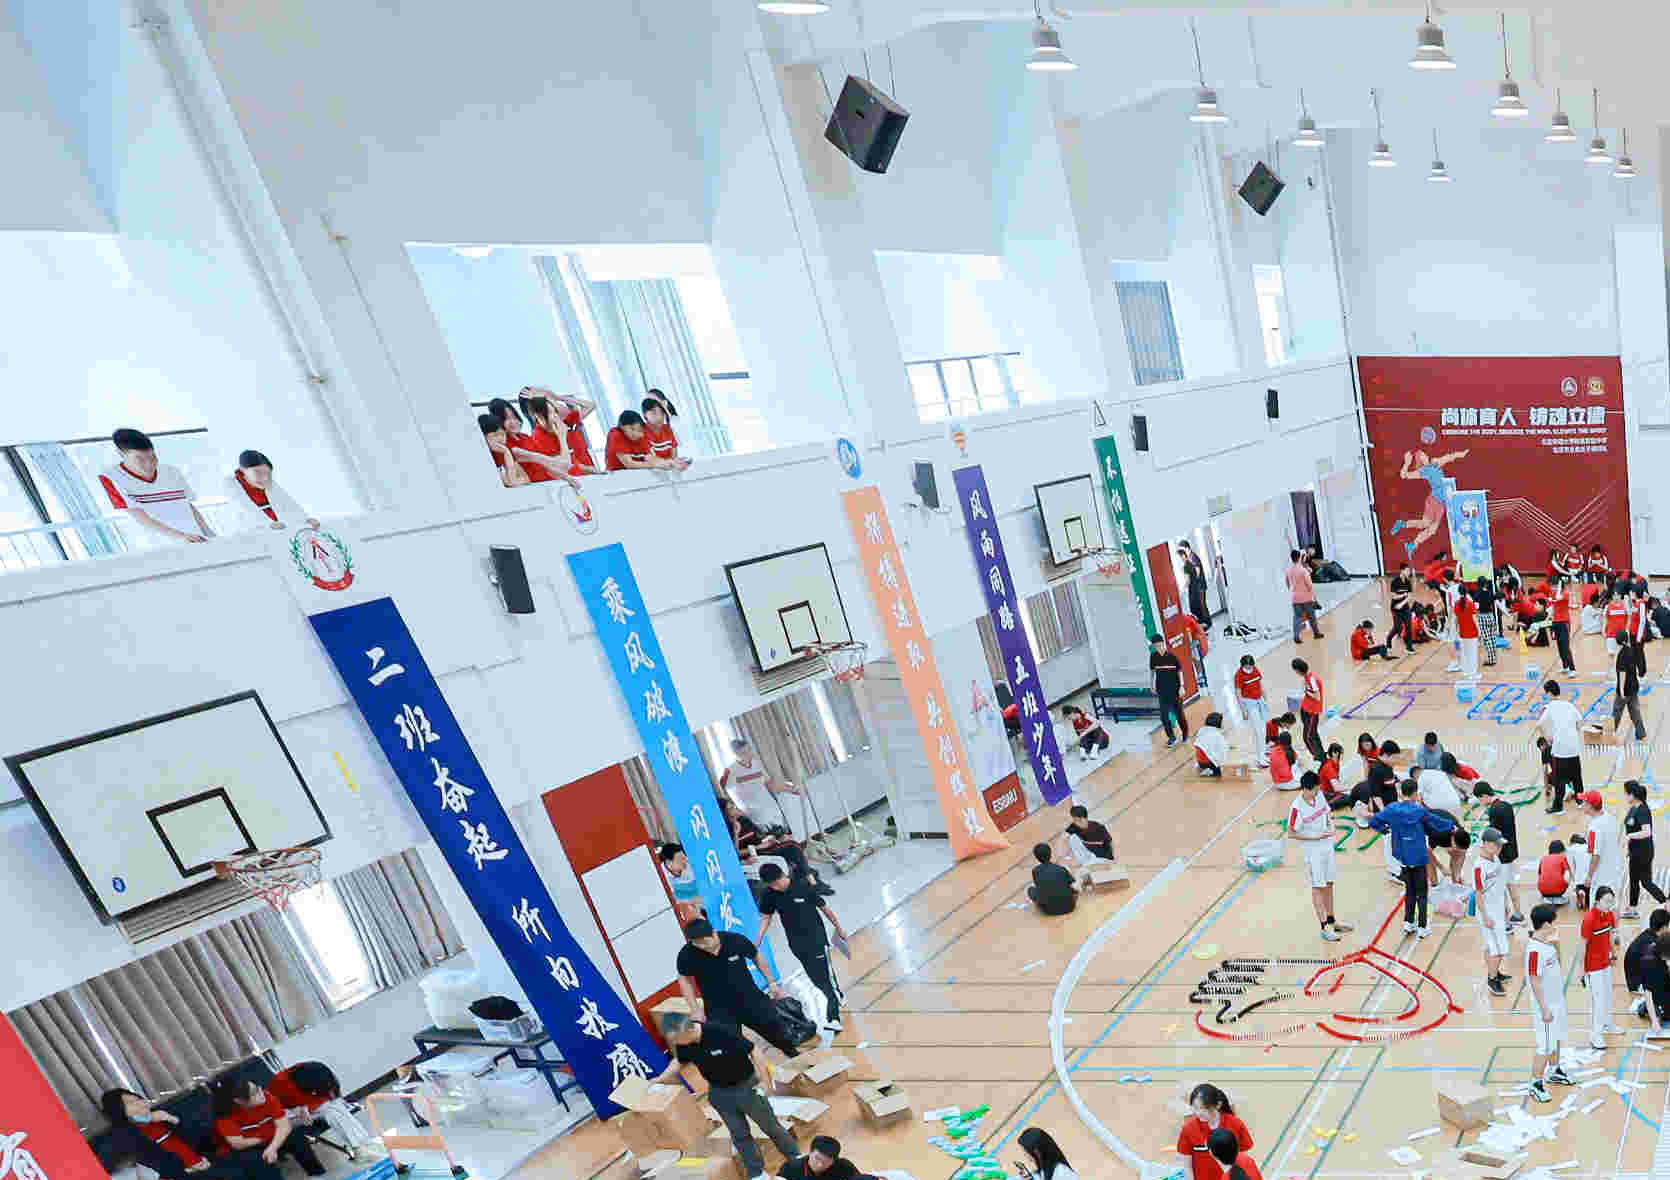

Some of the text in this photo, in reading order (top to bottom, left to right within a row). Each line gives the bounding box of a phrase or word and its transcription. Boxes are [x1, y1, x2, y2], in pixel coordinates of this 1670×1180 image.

[364, 645, 508, 871] 二班奋起
[600, 576, 743, 931] 乘风破浪 闪闪发
